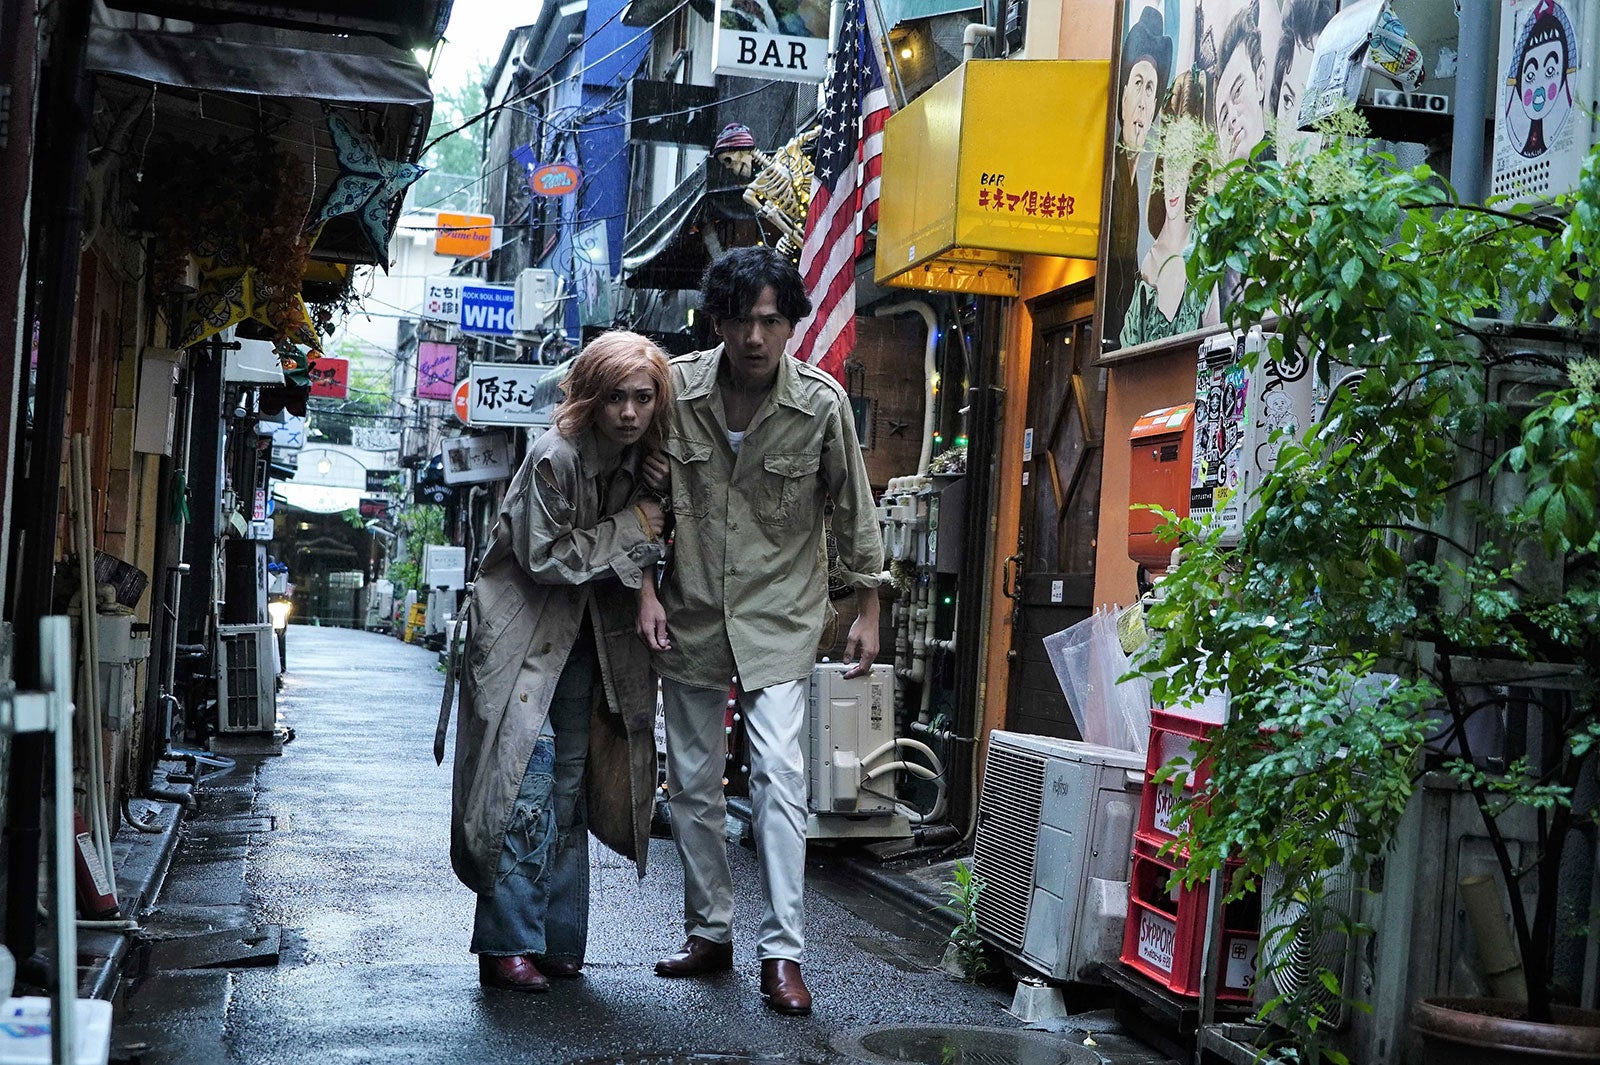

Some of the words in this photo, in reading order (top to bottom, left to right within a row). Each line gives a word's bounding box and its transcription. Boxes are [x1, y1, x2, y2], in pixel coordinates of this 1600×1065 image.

[737, 36, 808, 70] BAR
[1378, 91, 1446, 111] KAMO
[980, 172, 1005, 187] BAR
[979, 188, 1075, 219] キネマ倶楽部
[430, 286, 458, 298] たち
[463, 291, 479, 299] ROCK
[480, 293, 494, 301] SOUL
[495, 294, 514, 302] BLUES
